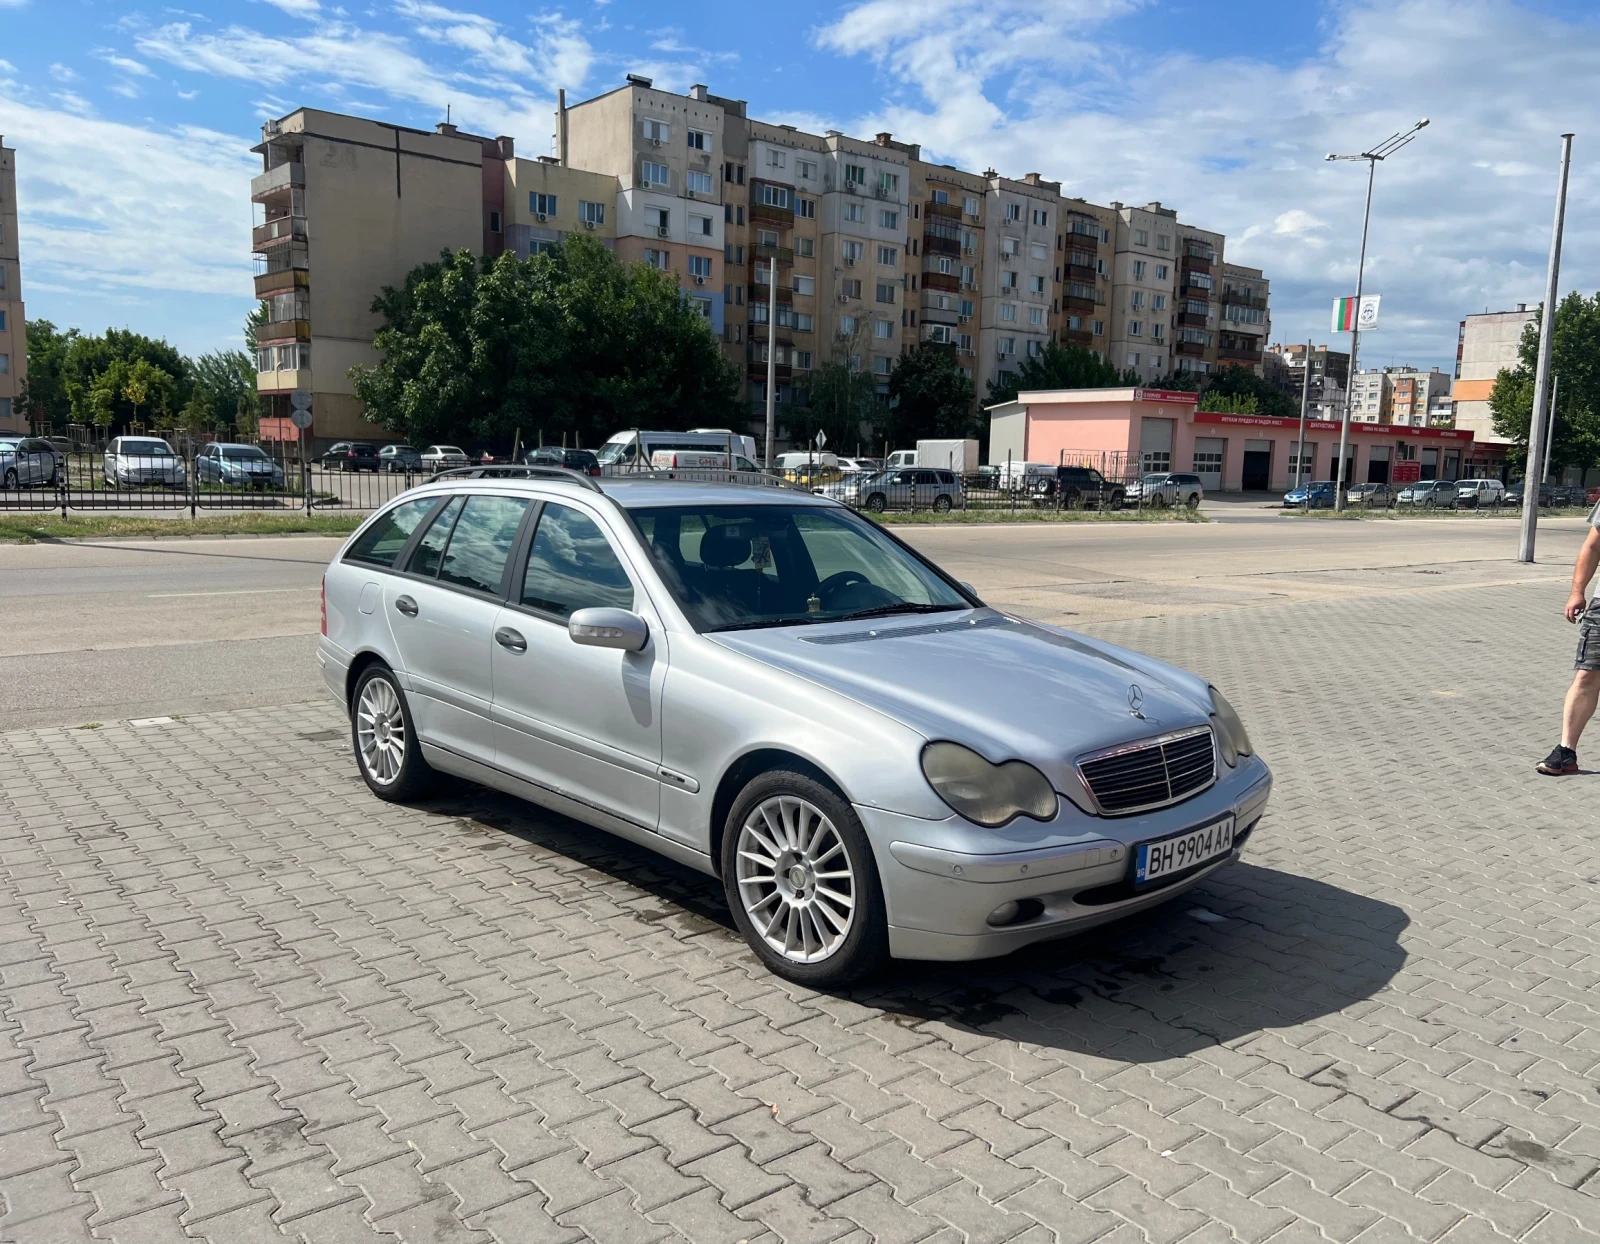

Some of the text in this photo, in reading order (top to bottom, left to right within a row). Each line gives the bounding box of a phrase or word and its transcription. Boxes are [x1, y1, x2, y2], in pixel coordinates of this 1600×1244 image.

[1149, 821, 1230, 875] BH 9904 AA
[1136, 867, 1145, 878] BG
